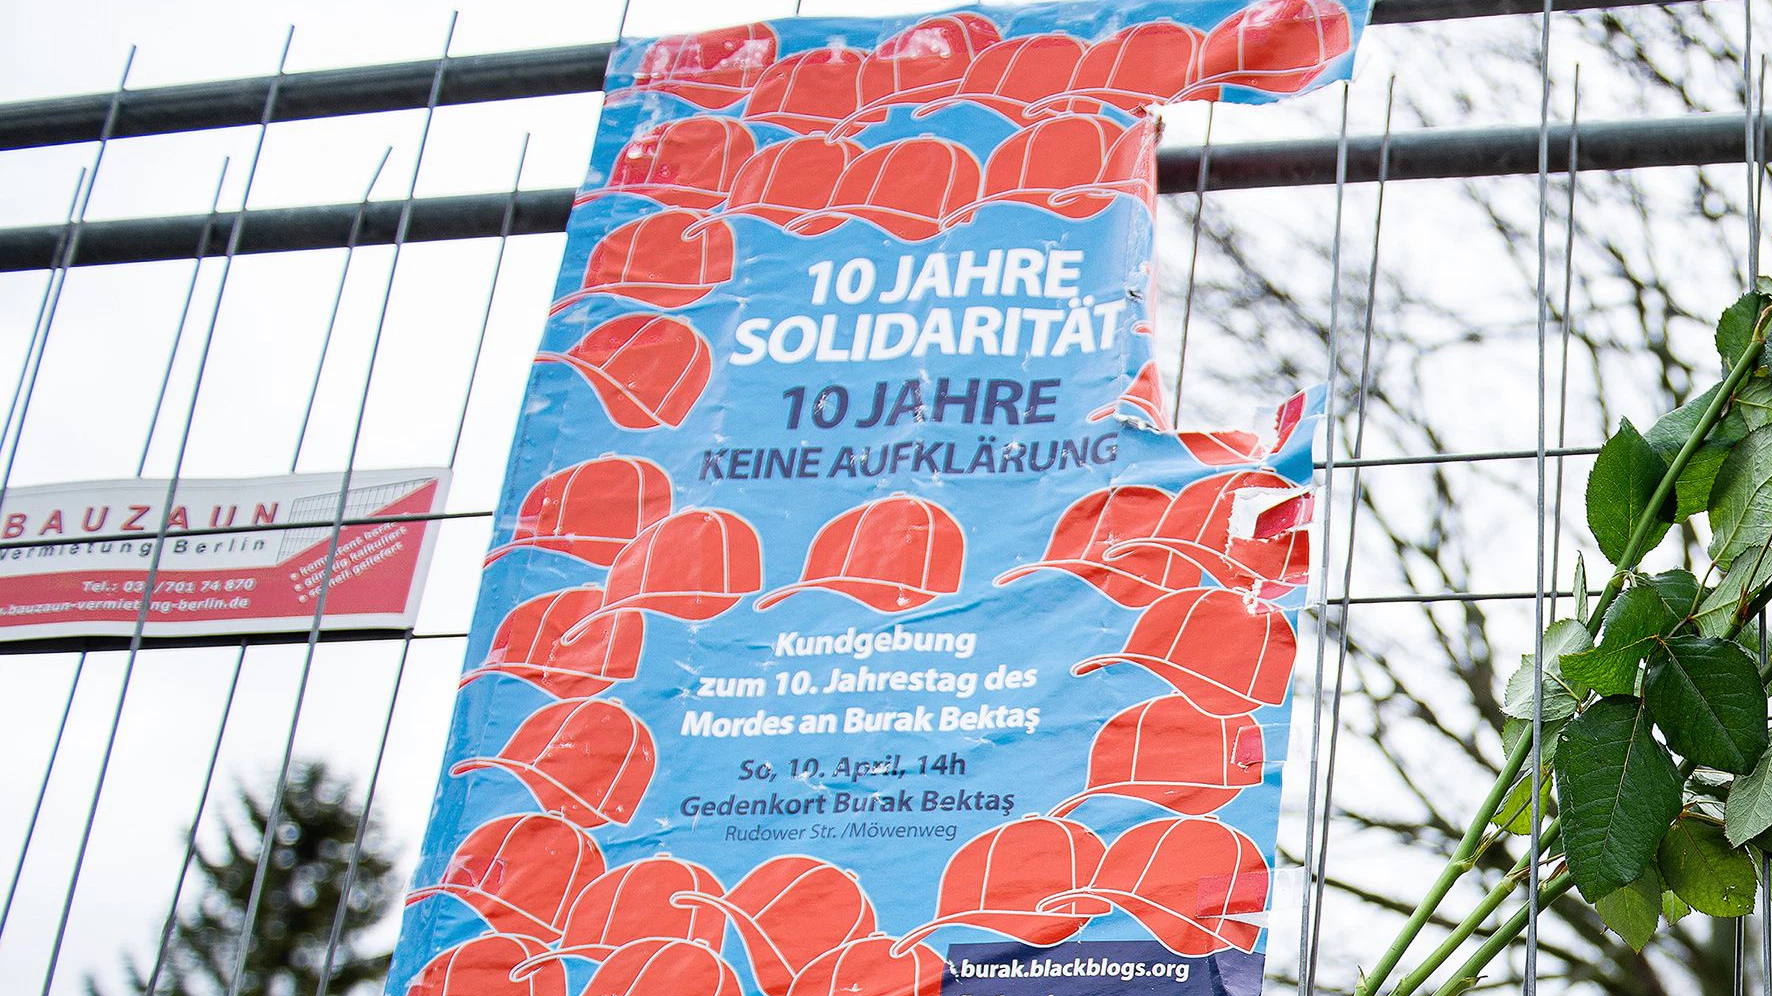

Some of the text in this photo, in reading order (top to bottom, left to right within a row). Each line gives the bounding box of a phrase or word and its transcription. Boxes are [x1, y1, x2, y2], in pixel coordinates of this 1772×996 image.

[807, 249, 1084, 305] 10 JAHRE
[728, 297, 1128, 367] SOLIDARITÄT
[781, 378, 1061, 431] 10 JAHRE
[699, 432, 1119, 482] KEINE AUFKLÄRUNG
[2, 502, 279, 539] BAUZAUN
[173, 537, 265, 553] Berlin
[82, 581, 118, 592] Tel.:
[122, 580, 195, 594] 03/701
[200, 580, 220, 592] 74
[308, 569, 352, 598] scnell
[774, 625, 977, 660] Kundgebung
[697, 664, 1038, 698] zum 10. Jahrestag des
[680, 704, 1041, 738] Mordes an Burak Bektaş
[738, 752, 966, 783] So, 10. April, 14h
[680, 789, 1015, 818] Gedenkort Burak Bektaş
[724, 824, 806, 842] Rudower
[960, 958, 1190, 982] burak.blackblogs.org
